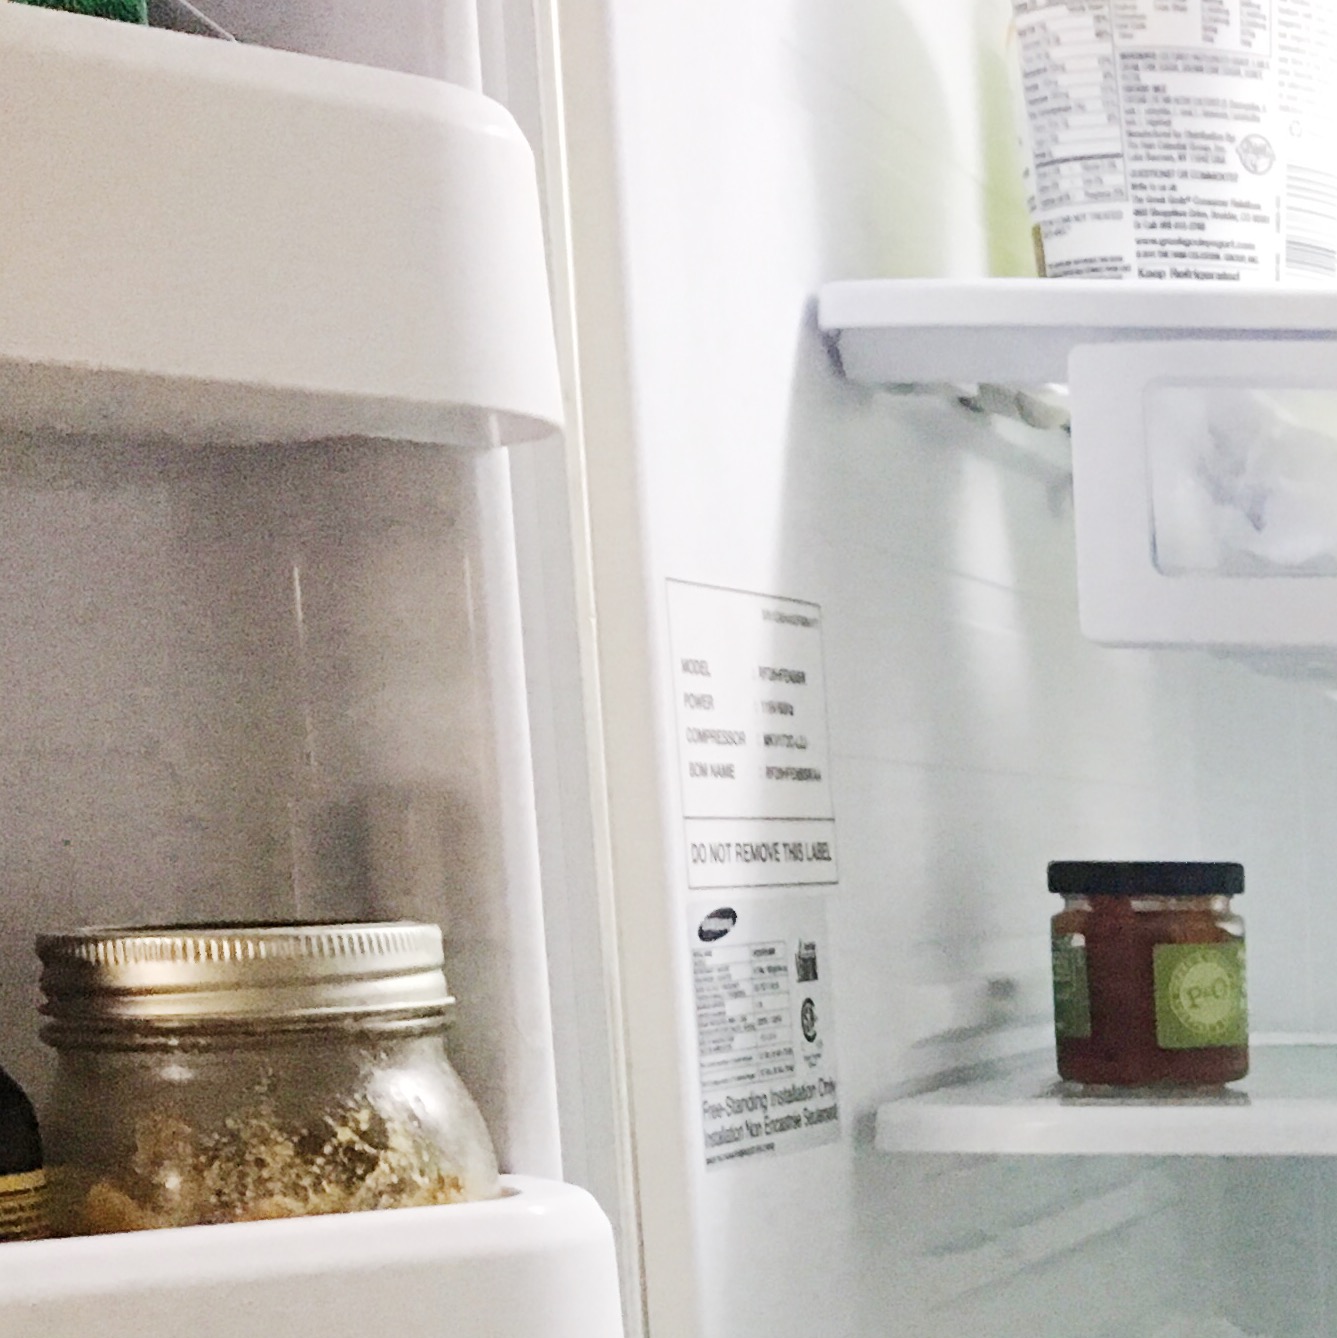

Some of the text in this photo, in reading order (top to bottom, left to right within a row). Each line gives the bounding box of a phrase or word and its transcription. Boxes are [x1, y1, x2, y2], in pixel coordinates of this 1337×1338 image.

[681, 658, 712, 678] MODEL
[684, 692, 715, 711] POWER
[686, 727, 746, 746] COMPRESSOR
[691, 842, 707, 863] DO
[709, 842, 733, 863] NOT
[735, 842, 781, 863] REMOVE
